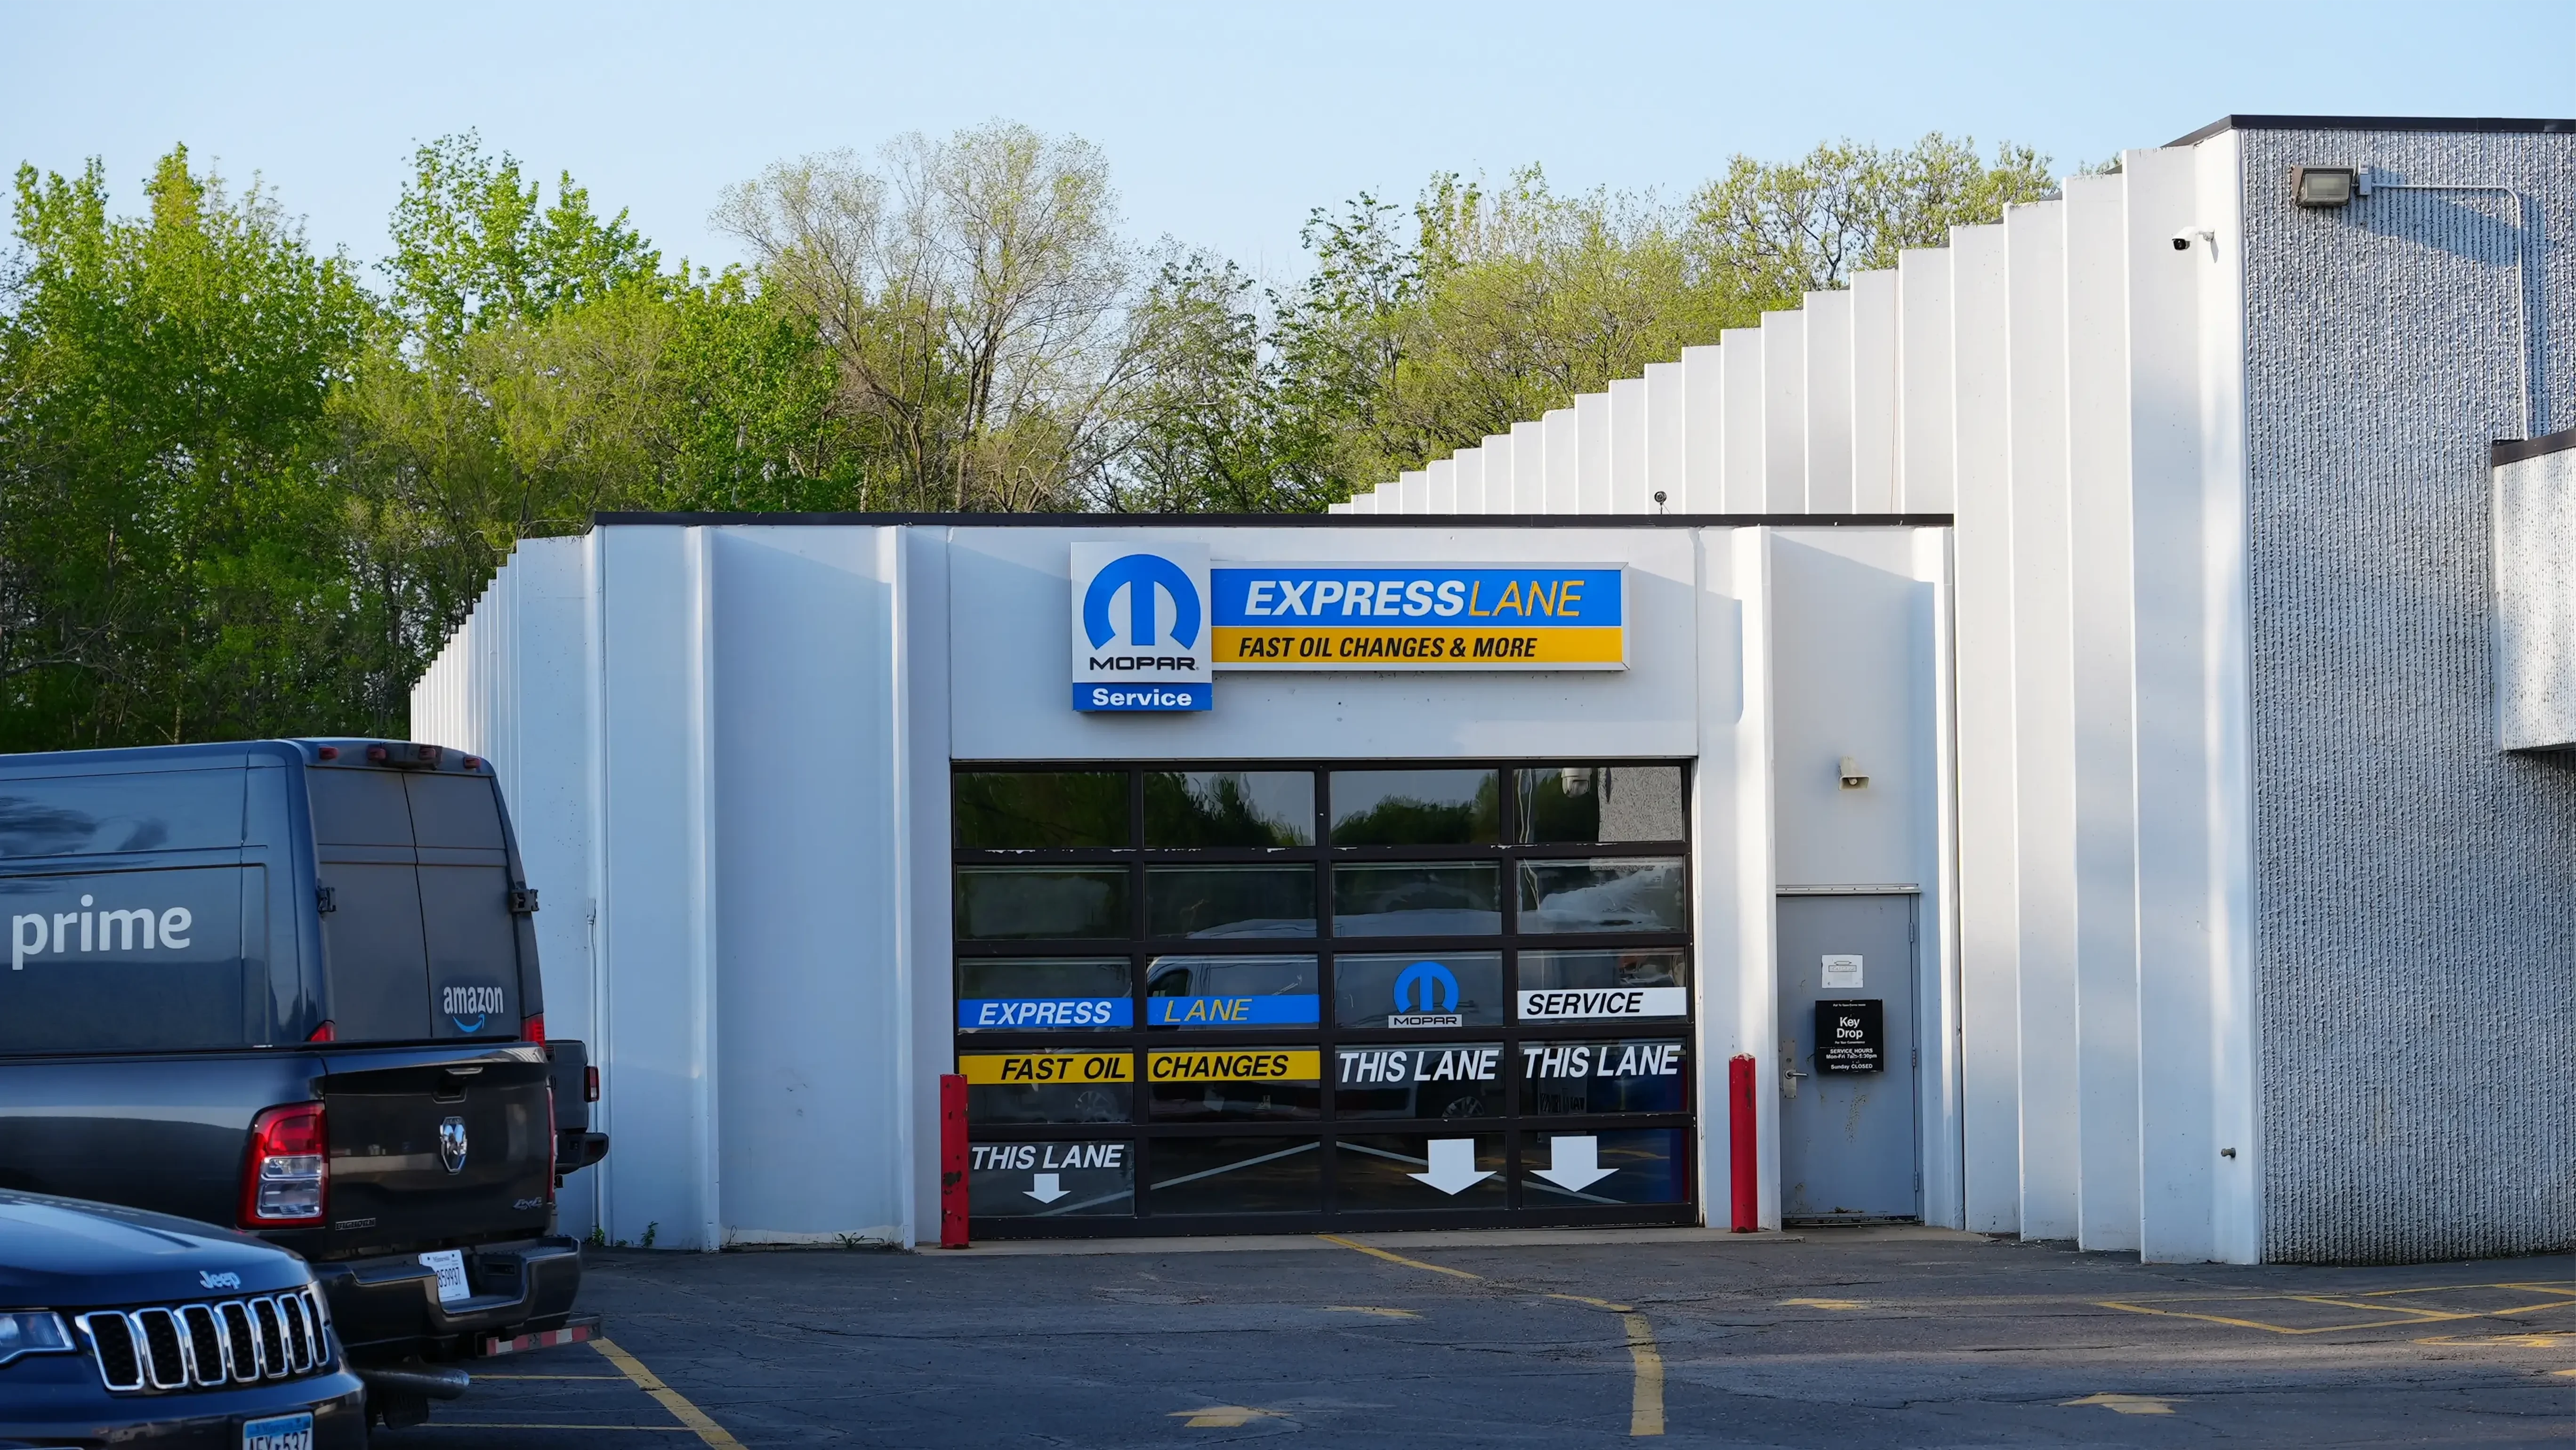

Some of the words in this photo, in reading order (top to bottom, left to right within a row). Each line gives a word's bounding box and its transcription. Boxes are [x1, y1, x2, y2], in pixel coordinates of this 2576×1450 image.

[1239, 637, 1294, 658] FAST
[1299, 637, 1333, 658] OIL
[1339, 636, 1443, 658] CHANGES
[1449, 637, 1466, 658] &
[1473, 637, 1538, 658] MORE
[1089, 656, 1196, 671] MOPAR
[1092, 688, 1192, 707] Service
[12, 894, 192, 970] prime
[443, 986, 504, 1014] amazon
[978, 1001, 1112, 1025] EXPRESS
[1164, 999, 1253, 1023] LANE
[1527, 992, 1643, 1016] SERVICE
[1394, 1016, 1457, 1025] MOPAR
[1840, 1017, 1860, 1029] Key
[1836, 1028, 1863, 1040] Drop
[1001, 1058, 1073, 1080] FAST
[1084, 1057, 1127, 1079] OIL
[1152, 1055, 1289, 1079] CHANGES
[1339, 1051, 1406, 1083] THIS
[1414, 1050, 1500, 1081] LANE
[1523, 1047, 1591, 1079] THIS
[1597, 1045, 1682, 1077] LANE
[971, 1145, 1036, 1170] THIS
[1042, 1144, 1125, 1168] LANE
[200, 1271, 241, 1290] Jeep
